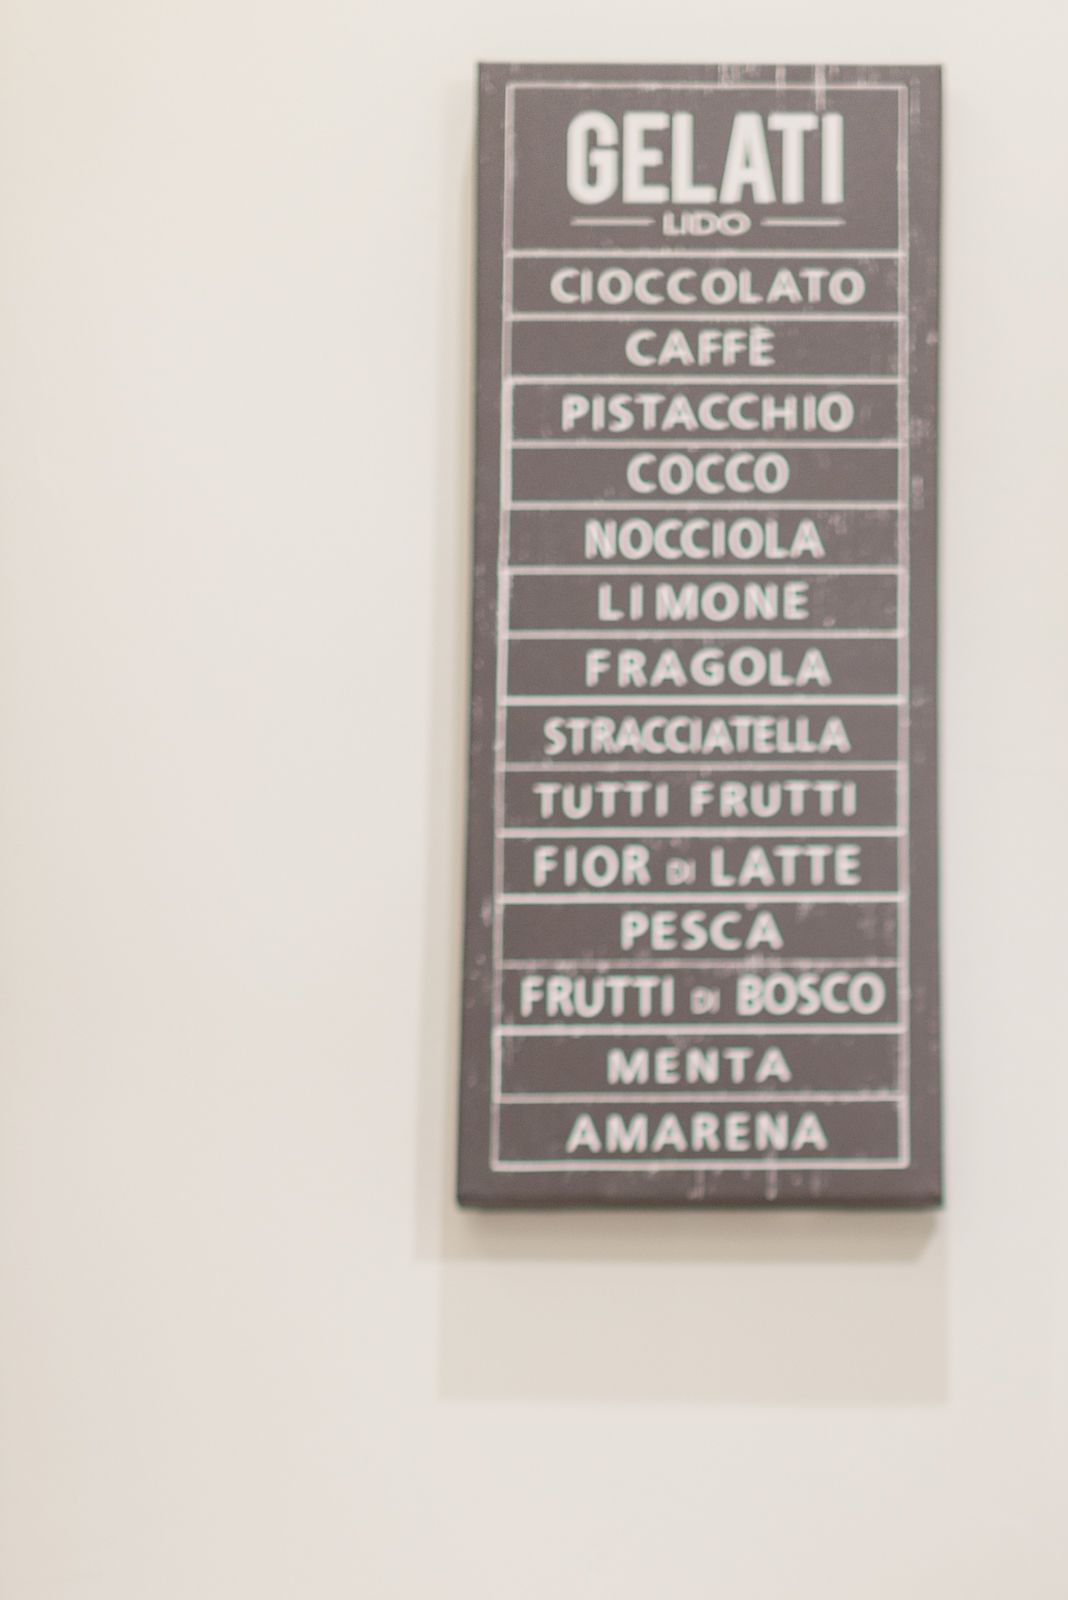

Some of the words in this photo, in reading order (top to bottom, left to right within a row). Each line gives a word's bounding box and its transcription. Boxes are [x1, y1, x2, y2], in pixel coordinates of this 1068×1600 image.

[566, 109, 844, 205] GELATI
[662, 211, 751, 235] LIDO
[550, 268, 866, 304] CIOCCOLATO
[625, 324, 776, 367] CAFFÈ
[561, 393, 854, 432] PISTACCHIO
[626, 453, 790, 495] COCCO
[584, 518, 825, 559] NOCCIOLA
[598, 581, 809, 621] LIMONE
[584, 647, 831, 688] FRAGOLA
[542, 716, 852, 755] STRACCIATELLA
[532, 780, 669, 819] TUTTI
[689, 780, 857, 818] FRUTTI
[533, 845, 650, 887] FIOR
[667, 858, 696, 885] DI
[710, 845, 862, 887] LATTE
[620, 910, 783, 951] PESCA
[520, 975, 674, 1018] FRUTTI
[690, 988, 719, 1013] DI
[736, 973, 885, 1016] BOSCO
[607, 1047, 792, 1085] MENTA
[566, 1111, 828, 1153] AMARENA
